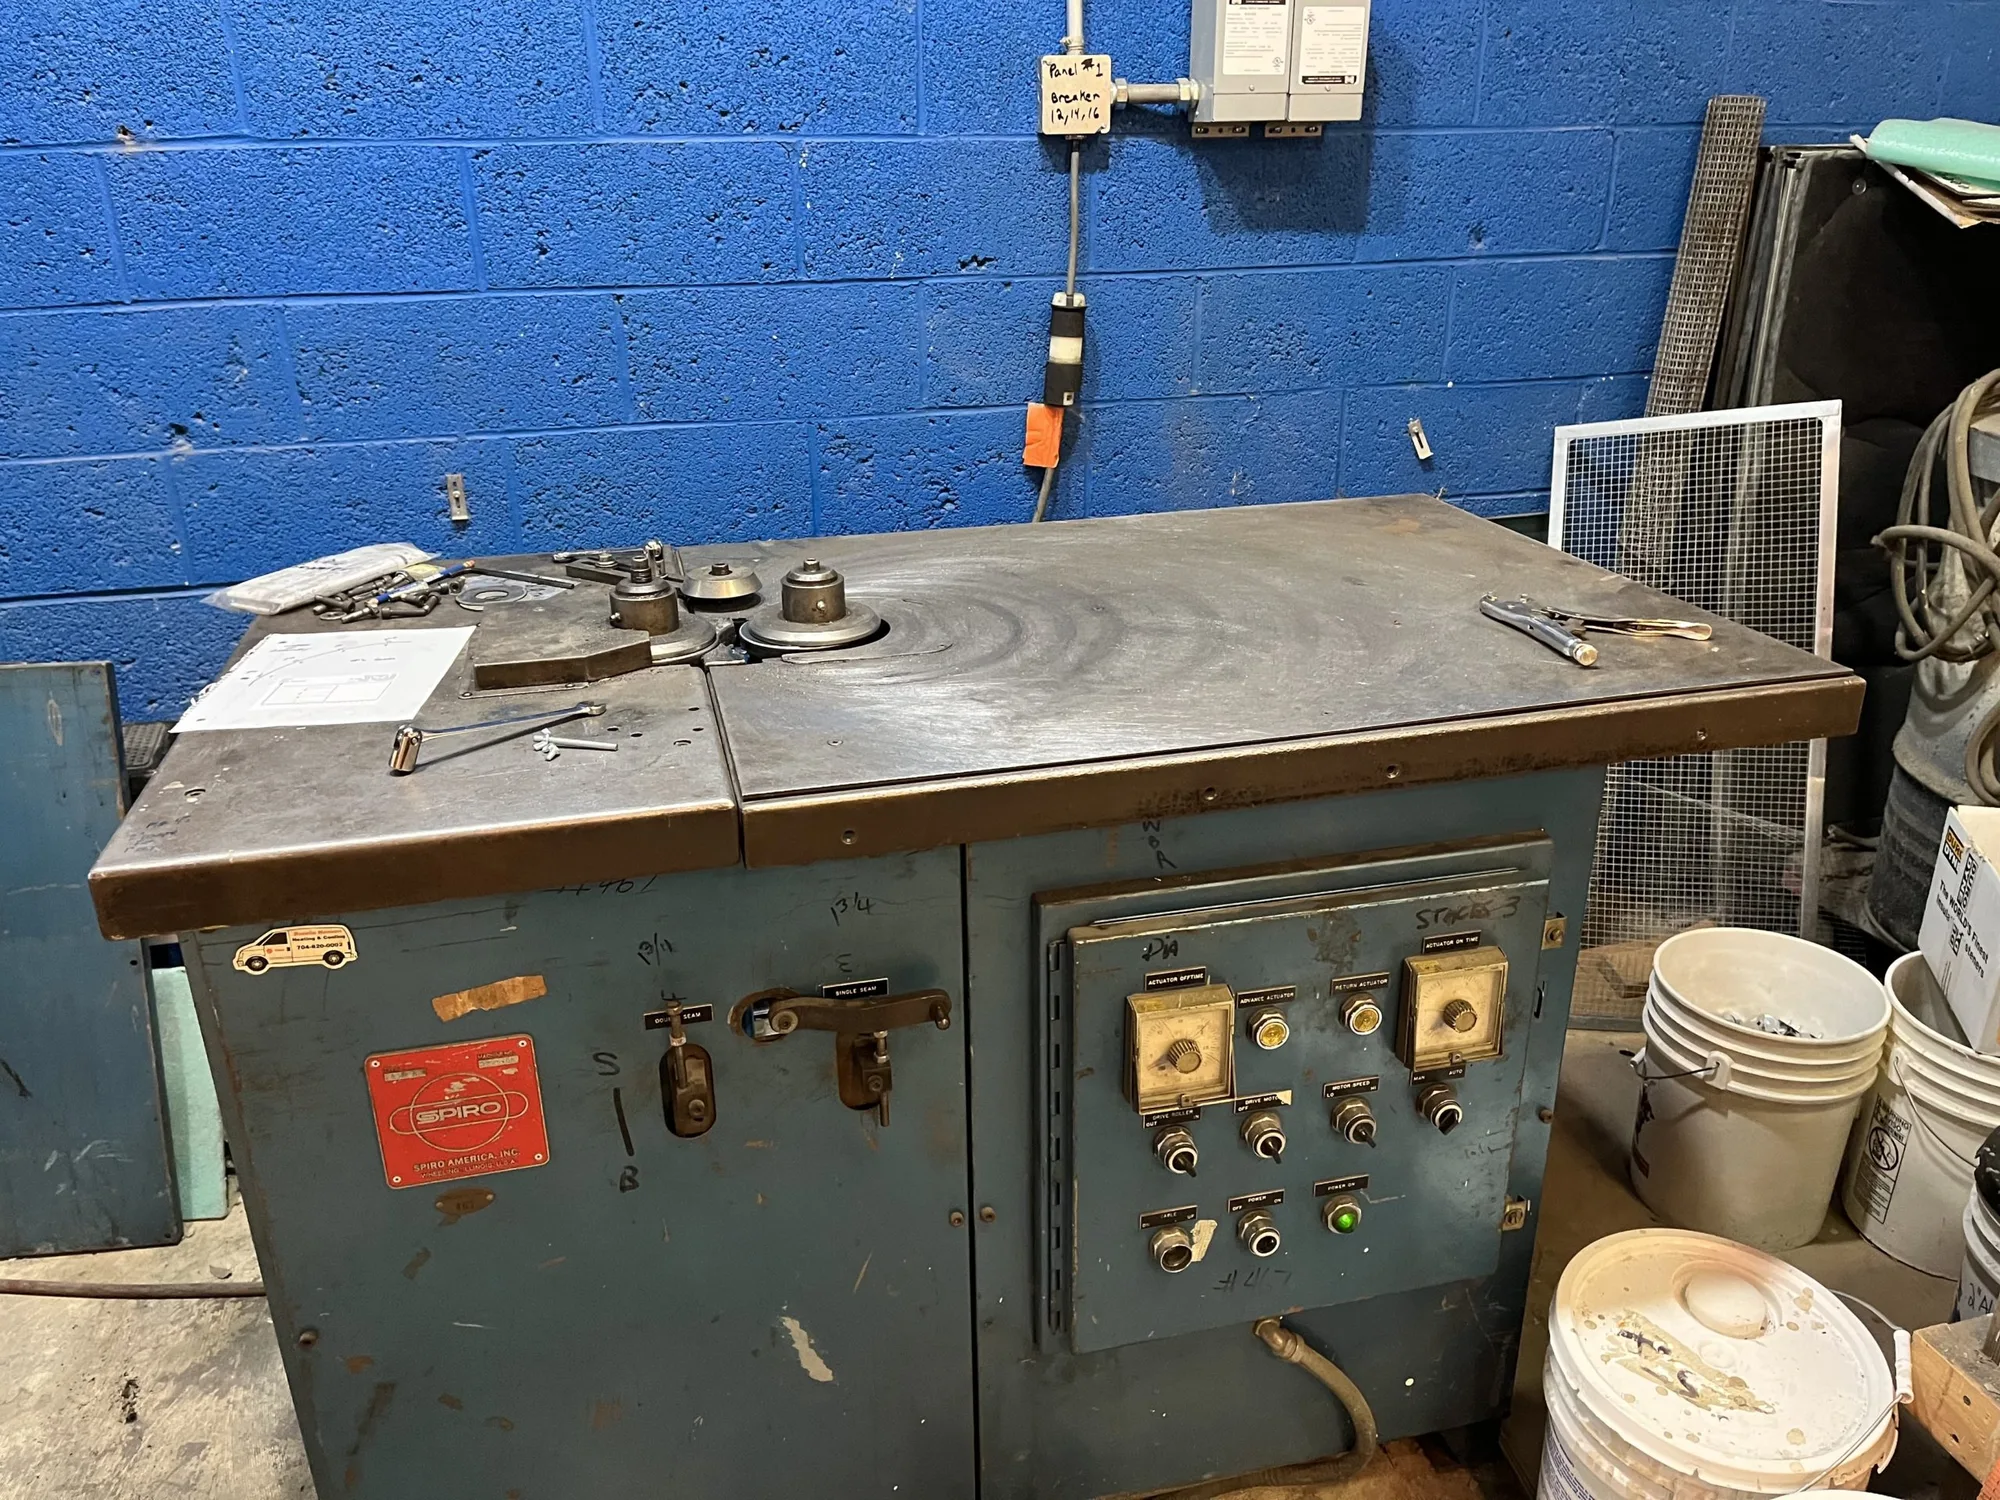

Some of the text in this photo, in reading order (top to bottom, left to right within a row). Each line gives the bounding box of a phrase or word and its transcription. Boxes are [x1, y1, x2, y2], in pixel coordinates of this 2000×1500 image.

[1049, 62, 1078, 79] Panel
[1051, 90, 1101, 104] Breaker
[1940, 879, 1989, 965] The WORLD'S Finest
[1425, 940, 1454, 949] ACTUATOR
[1148, 975, 1178, 986] ACTUATOR
[1335, 978, 1389, 991] RETURN ACTUATOR
[835, 985, 877, 997] SINGLE SEAM
[1240, 991, 1295, 1005] ADVANCE ACTUATOR
[683, 1011, 701, 1020] SEAM
[592, 1052, 621, 1076] S
[1449, 1068, 1463, 1076] AUTO
[1413, 1074, 1426, 1082] MAN
[1332, 1080, 1371, 1091] MOTOR SPEED
[1245, 1097, 1262, 1105] DRIVE
[416, 1101, 502, 1125] SPIRO
[1152, 1113, 1169, 1121] DRIVE
[1145, 1120, 1158, 1128] OUT
[413, 1160, 445, 1172] SPIRO
[500, 1148, 521, 1158] INC.
[619, 1164, 640, 1194] B
[1327, 1183, 1346, 1191] POWER
[1248, 1195, 1267, 1203] POWER
